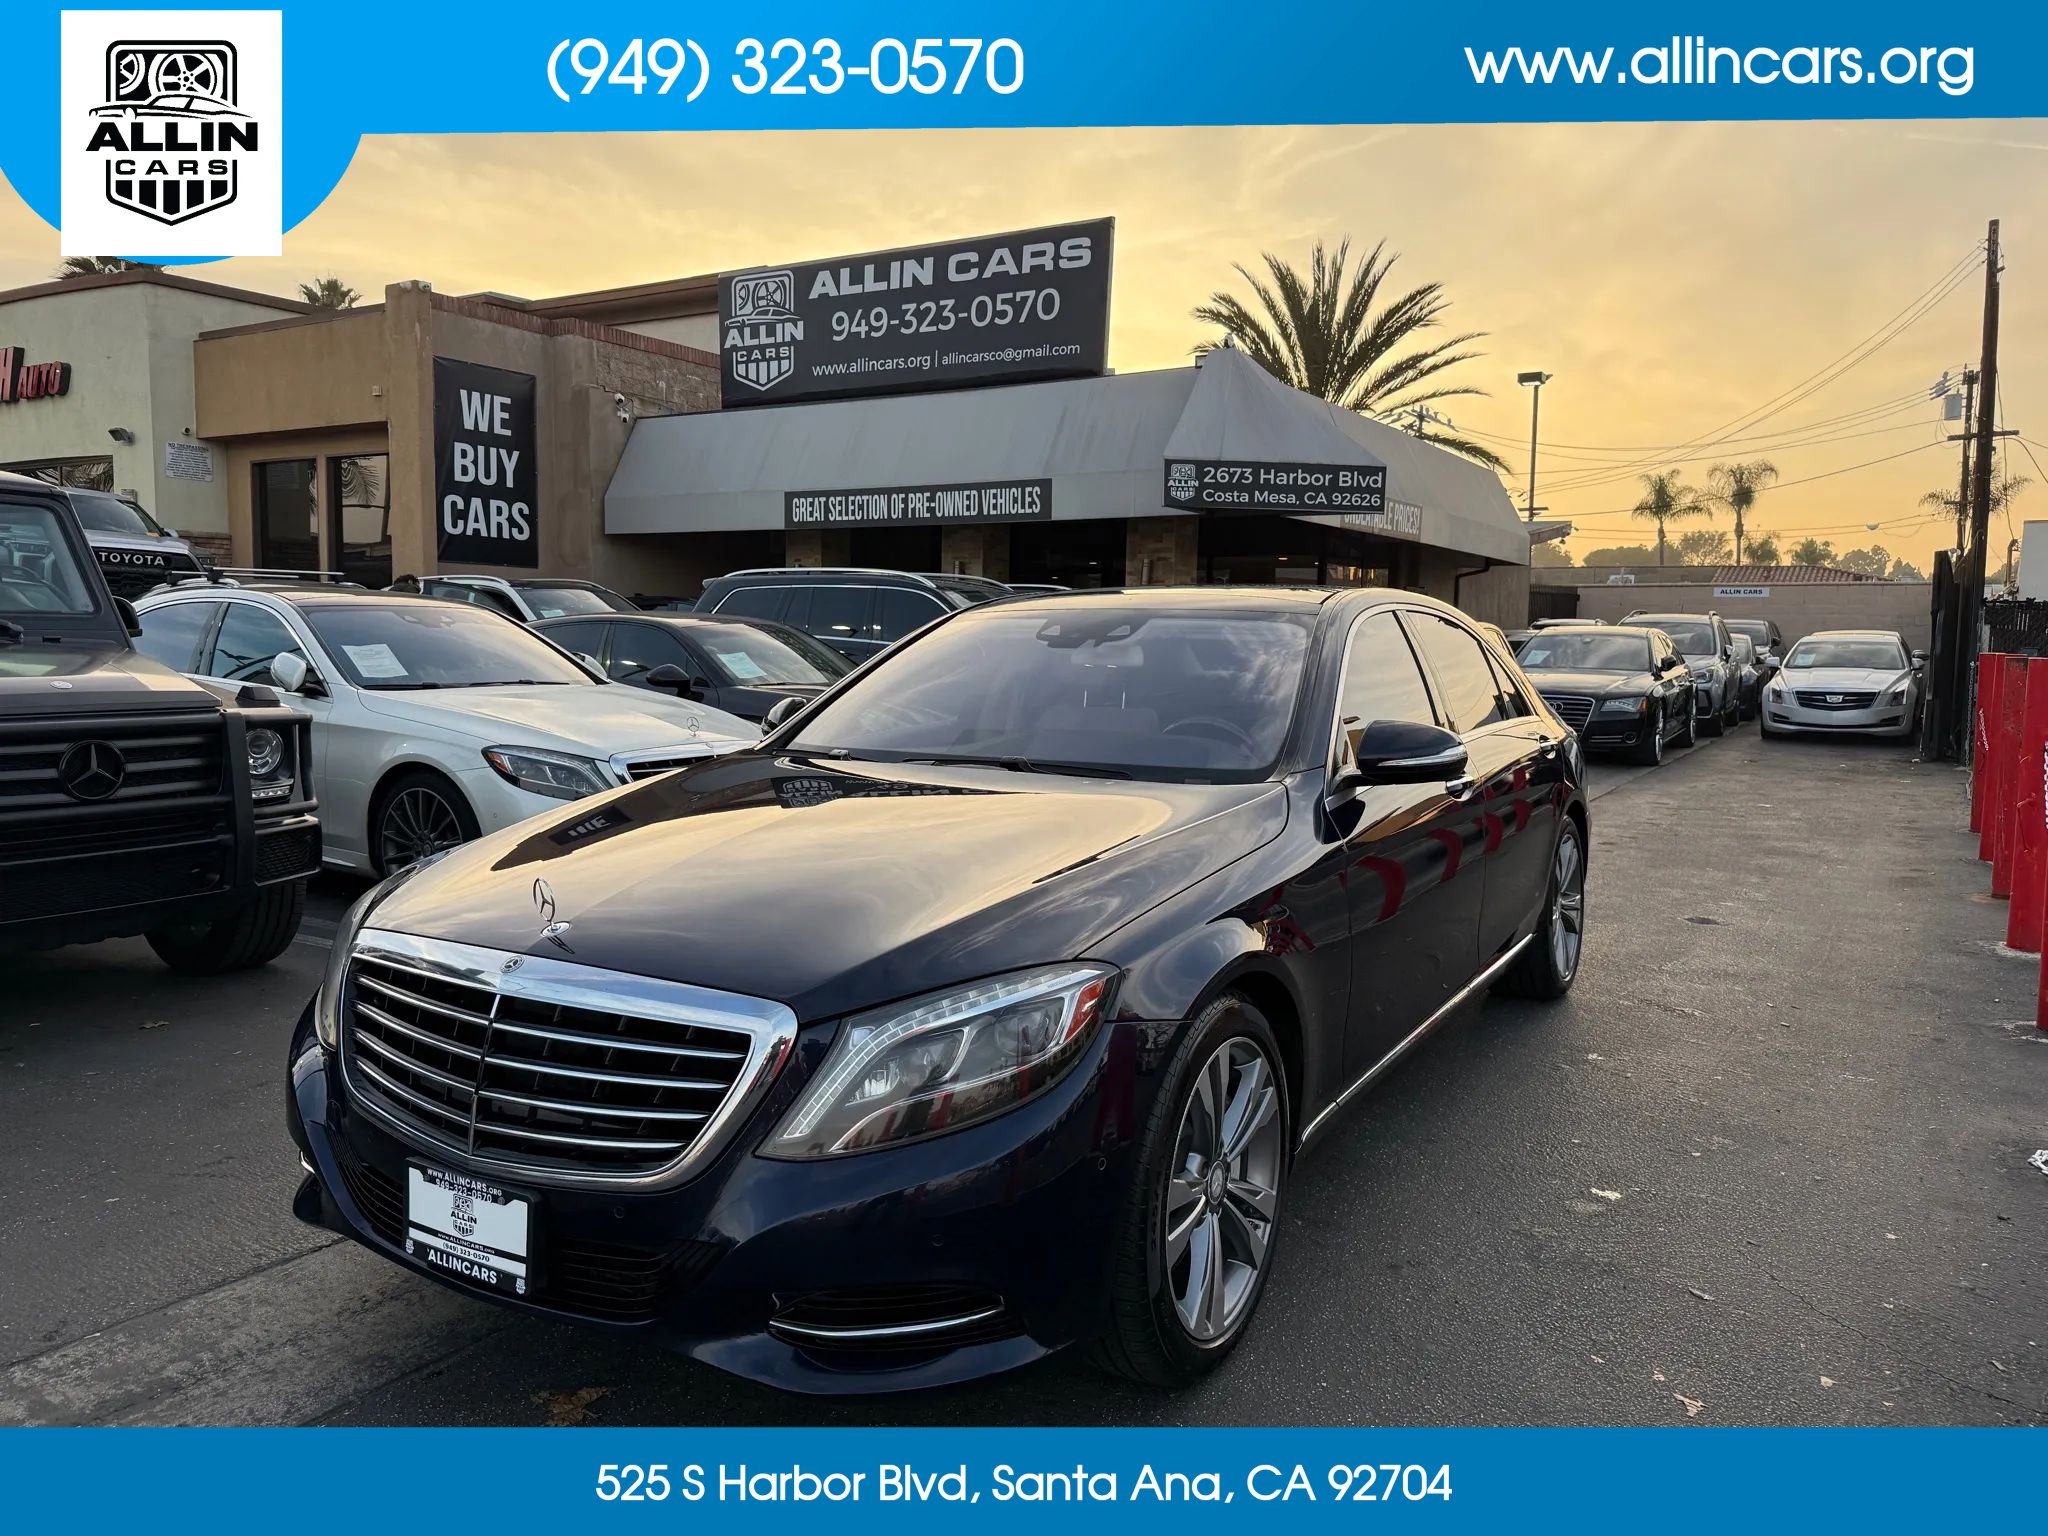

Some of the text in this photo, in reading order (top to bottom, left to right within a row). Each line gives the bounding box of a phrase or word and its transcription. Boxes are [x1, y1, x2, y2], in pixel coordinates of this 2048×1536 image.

[808, 236, 1092, 299] ALLIN CARS
[831, 288, 1060, 341] 949-323-0570
[724, 320, 804, 348] ALLIN
[737, 346, 790, 361] CARS
[812, 343, 1080, 377] www.allincars.org allincarsco@gmail.com
[460, 389, 512, 436] WE
[454, 441, 520, 488] BUY
[1203, 467, 1382, 488] 2673 Harbor Blvd
[792, 486, 1041, 522] GREAT SELECTION OF PRE-OWNED VEHICLES
[1202, 489, 1381, 506] Costa Mesa, CA 92626
[443, 494, 530, 541] CARS
[99, 552, 165, 566] TOYOTA
[450, 1211, 477, 1225] ALLIN
